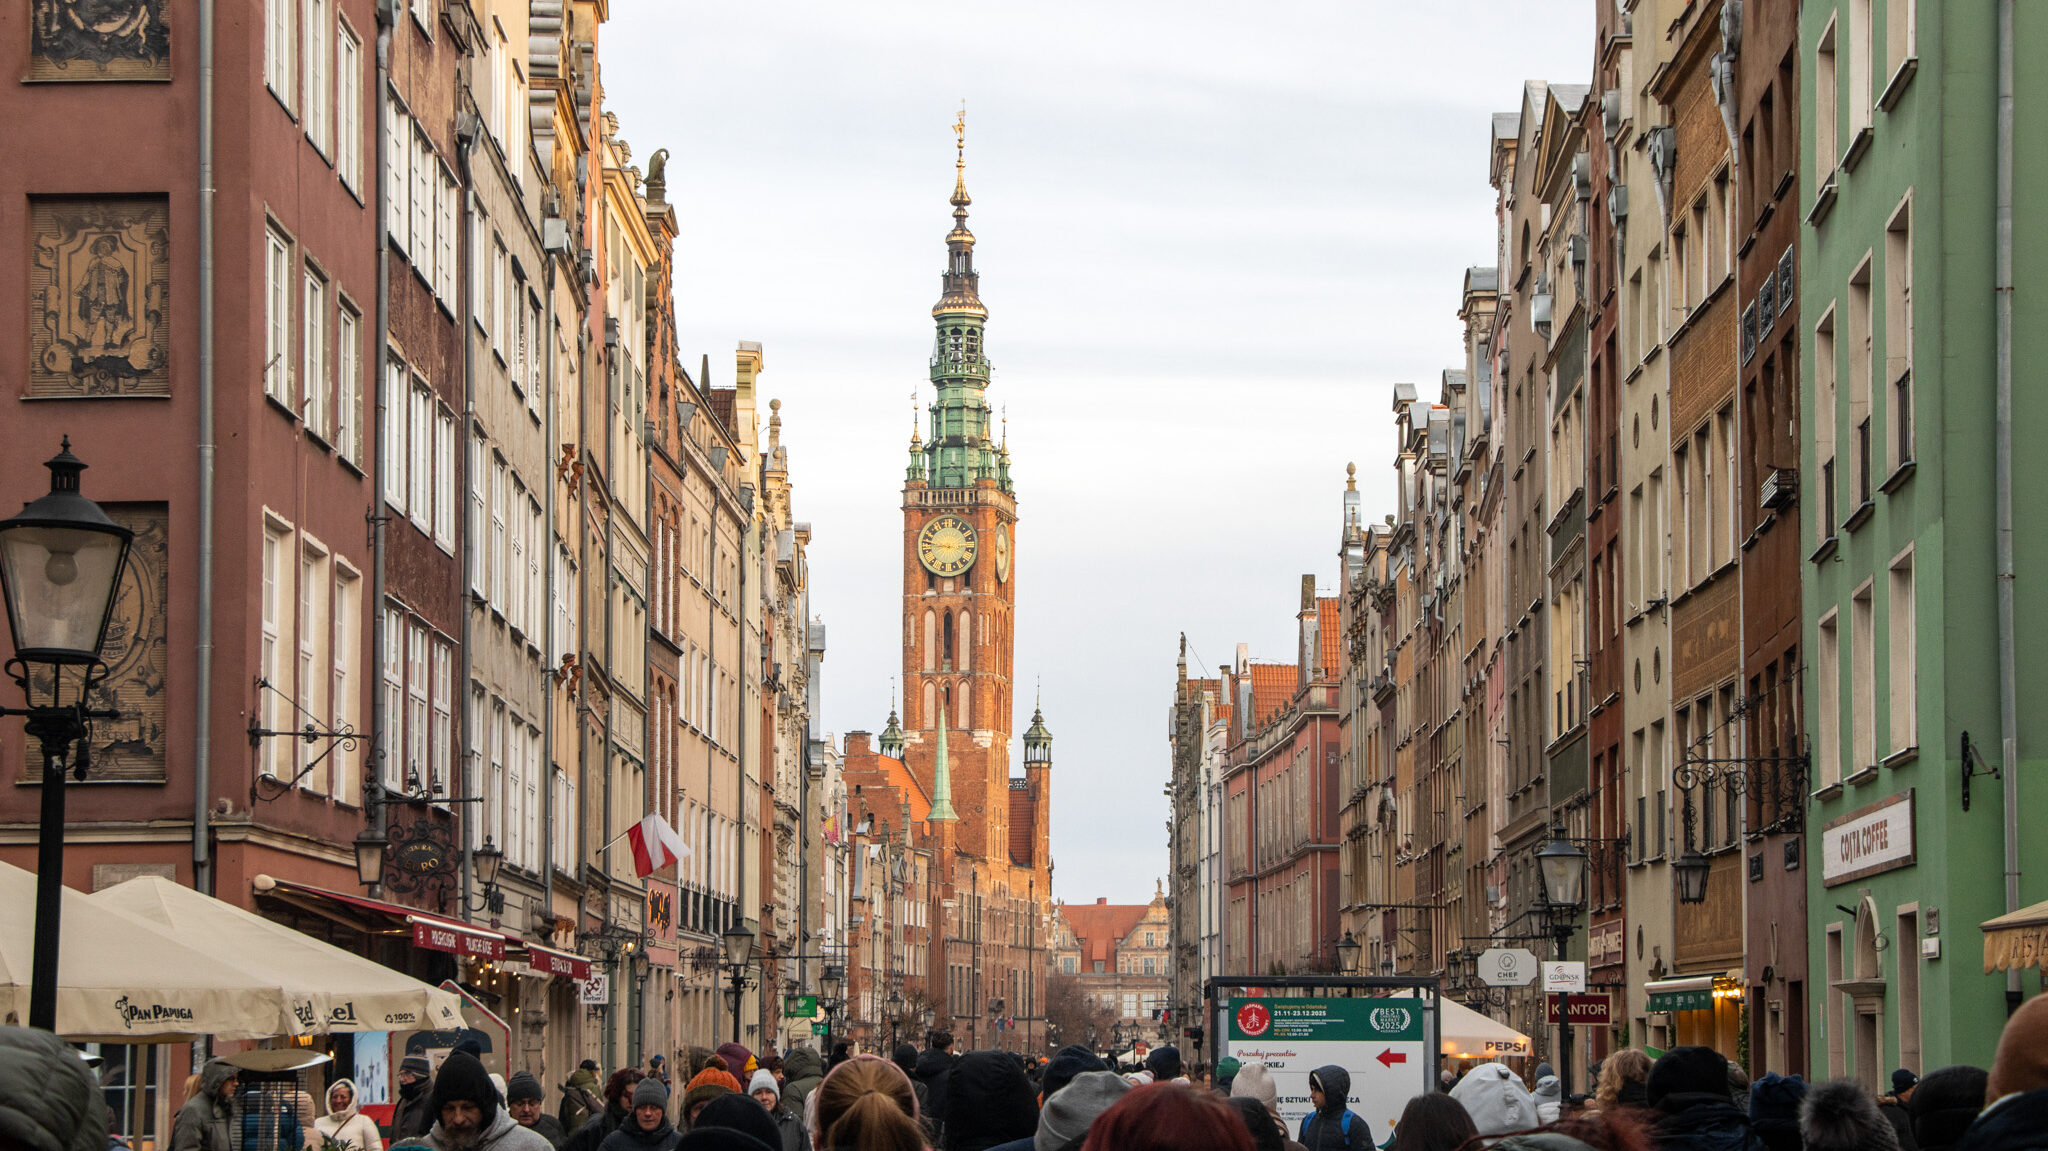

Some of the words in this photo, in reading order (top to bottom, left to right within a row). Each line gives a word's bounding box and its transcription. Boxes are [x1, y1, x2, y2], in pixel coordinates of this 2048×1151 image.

[1840, 829, 1860, 865] COSTA
[1862, 819, 1888, 856] COFFEE
[1551, 1004, 1607, 1016] KNTOR
[393, 1012, 415, 1021] 100%
[1380, 1022, 1400, 1030] 2025
[1485, 1041, 1526, 1052] PEPSI
[1237, 1049, 1264, 1060] Poszukaj
